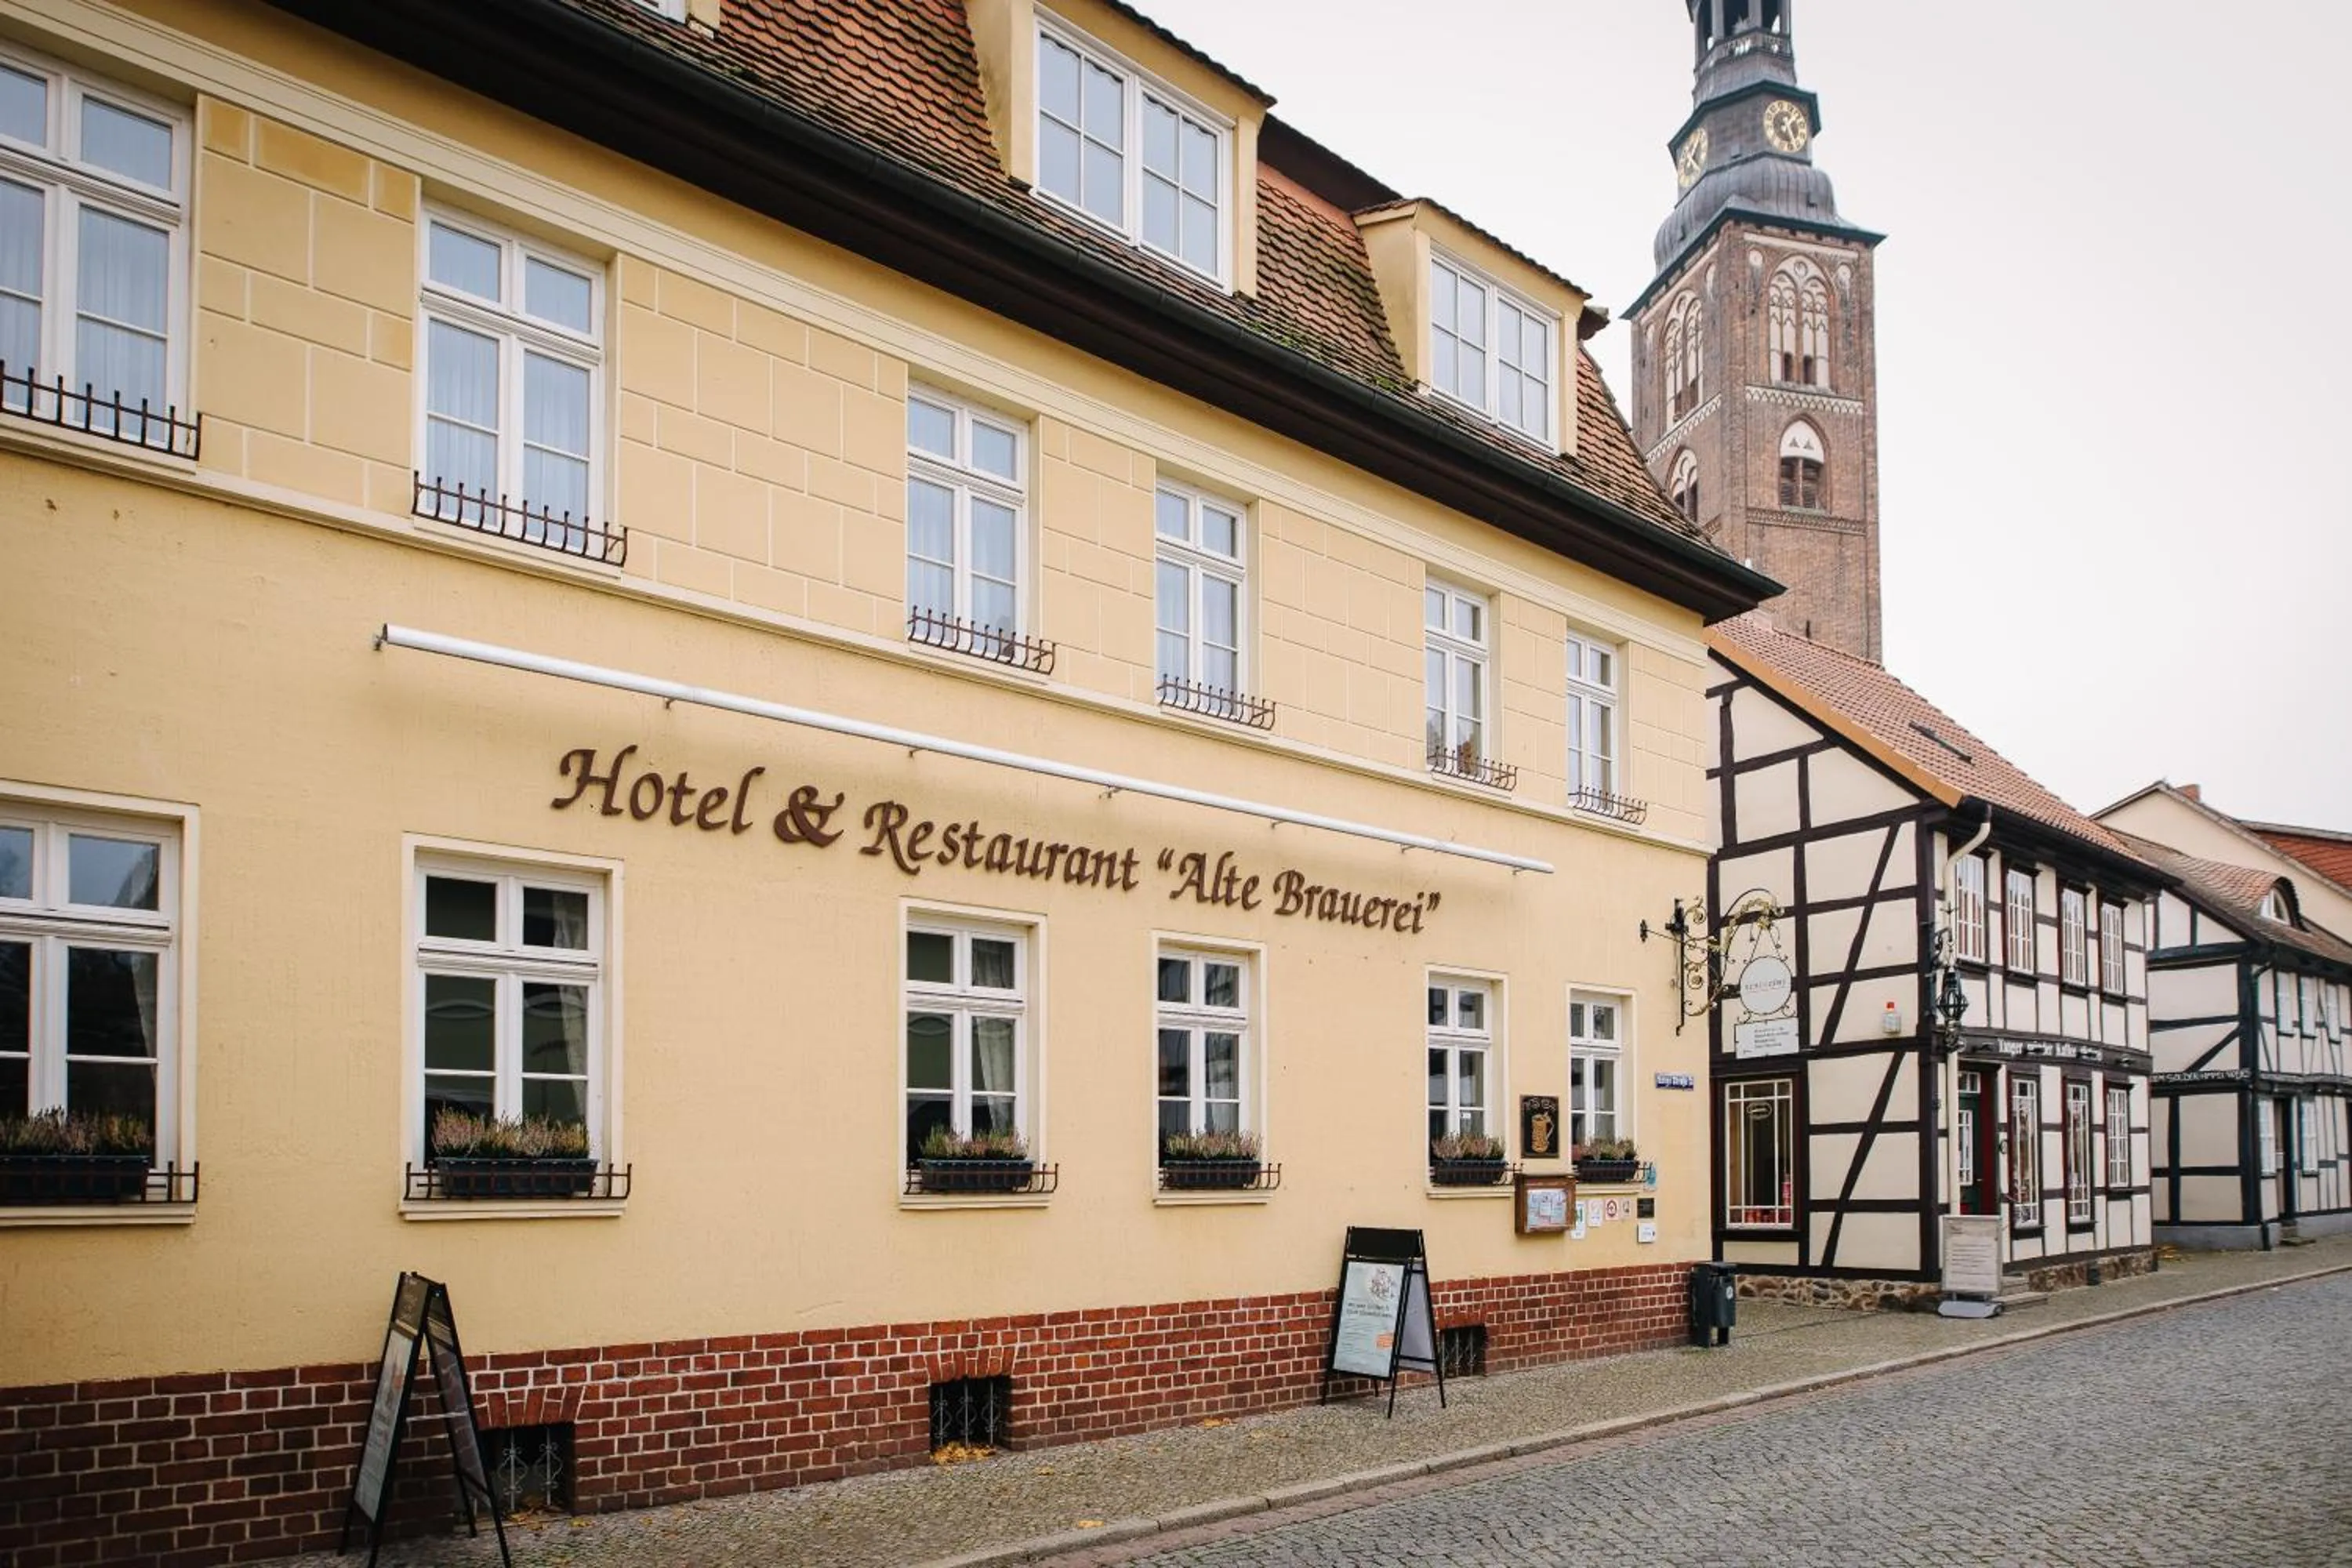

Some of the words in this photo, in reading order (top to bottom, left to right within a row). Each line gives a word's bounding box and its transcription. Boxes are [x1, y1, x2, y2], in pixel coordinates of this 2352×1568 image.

[550, 744, 766, 835] Hotel
[772, 785, 845, 849] &
[858, 800, 1140, 892] Restaurant
